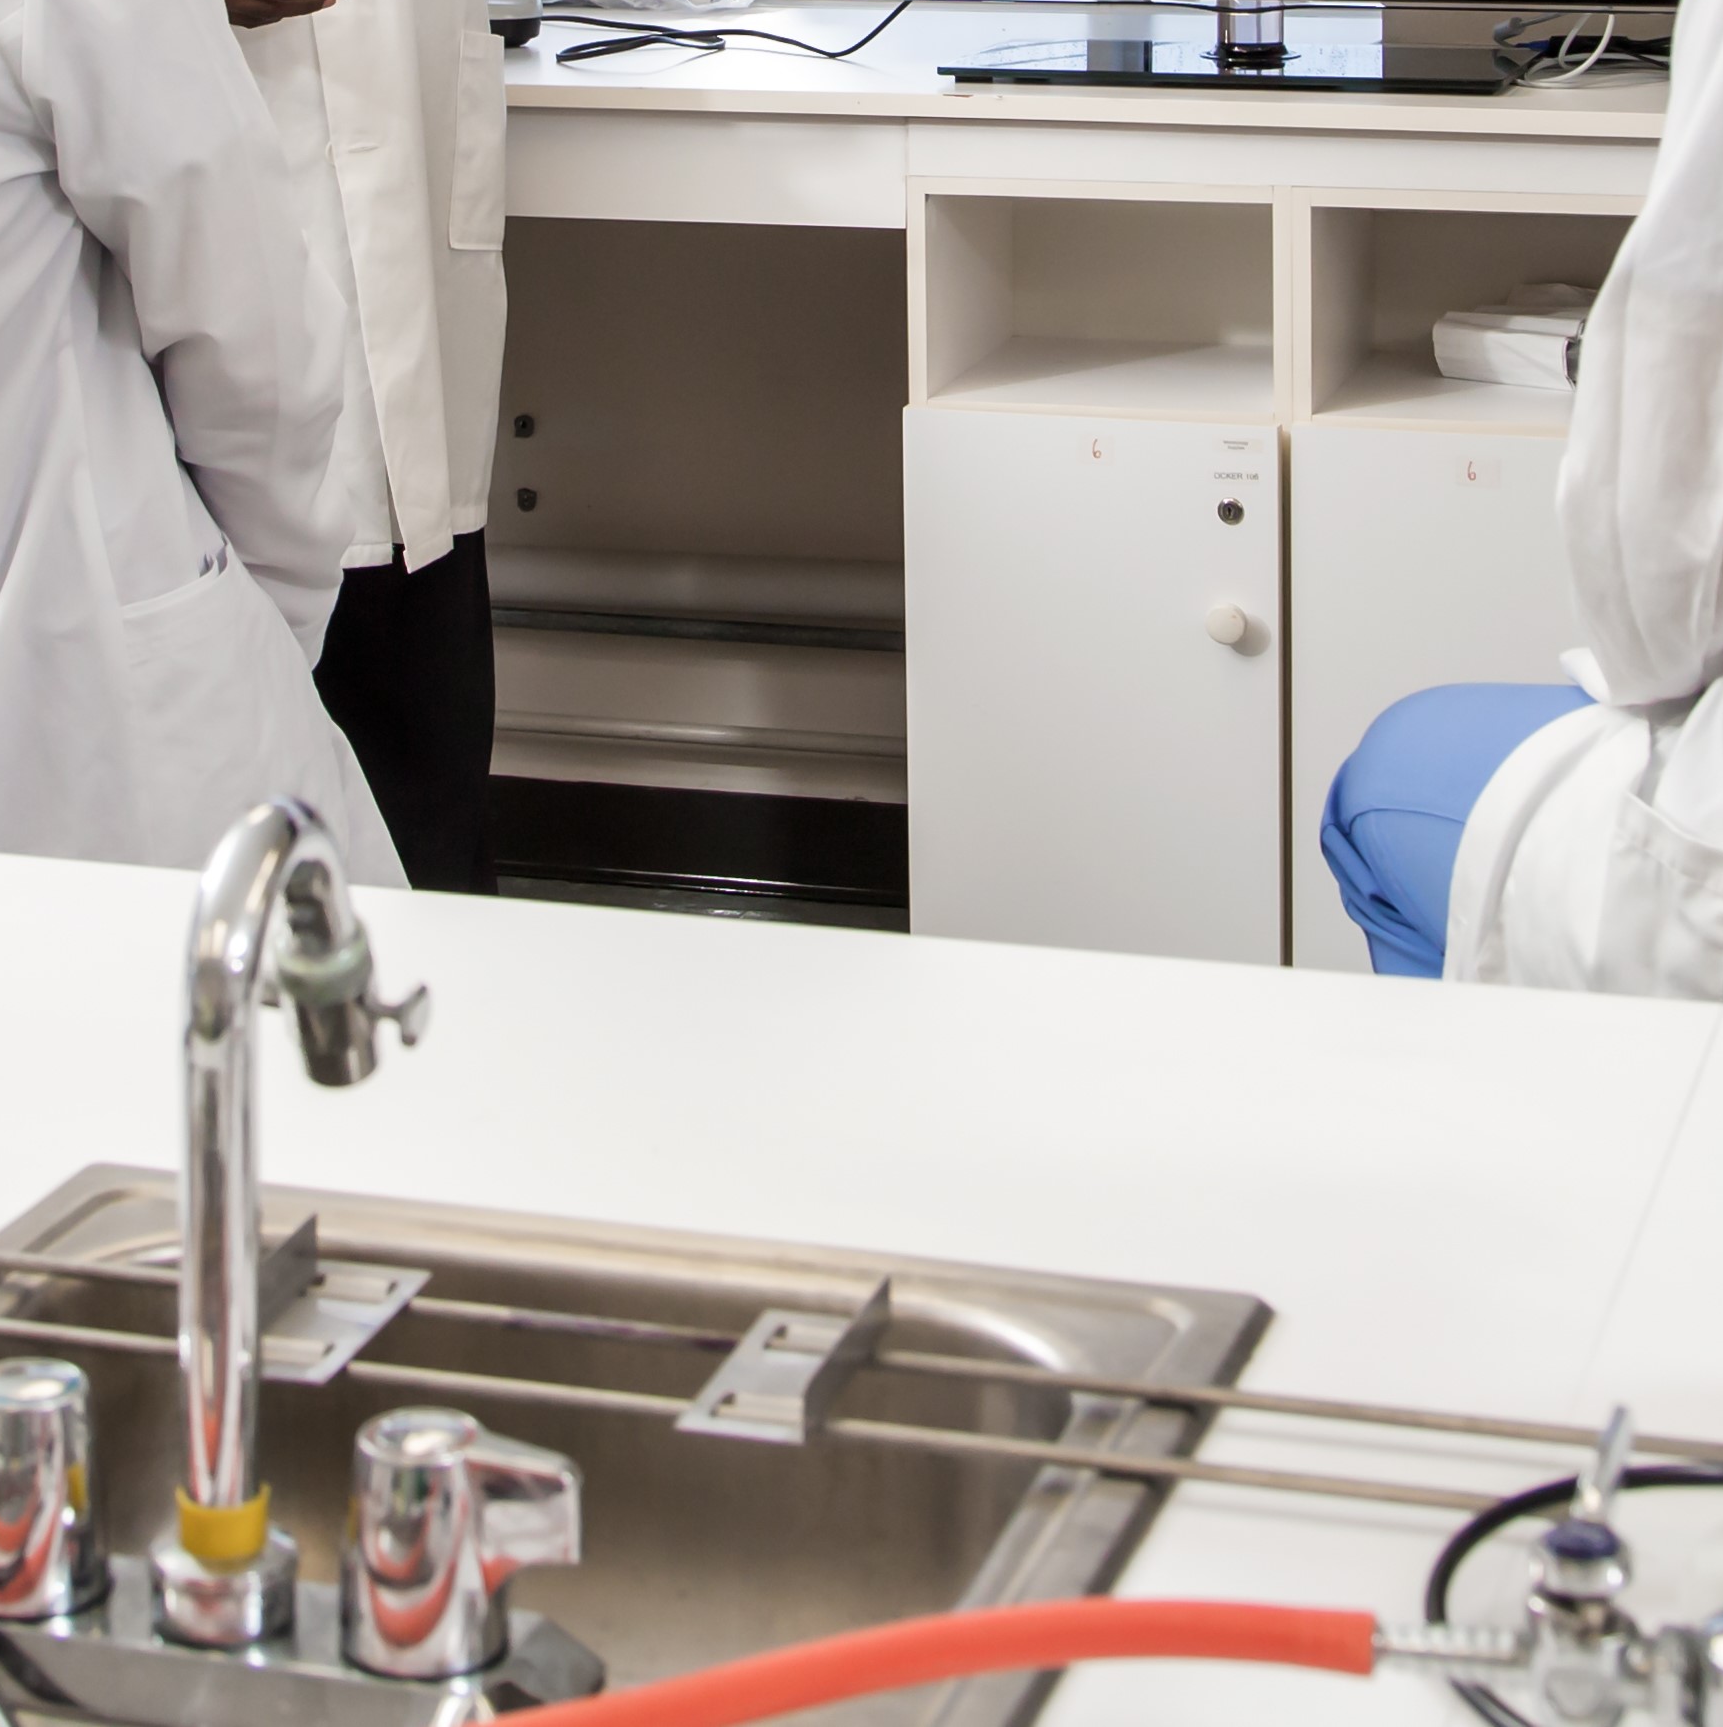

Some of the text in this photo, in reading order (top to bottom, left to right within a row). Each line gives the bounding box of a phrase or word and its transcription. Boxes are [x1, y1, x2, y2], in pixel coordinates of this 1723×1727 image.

[1092, 438, 1102, 459] 6
[1213, 472, 1243, 480] OCKER
[1467, 461, 1477, 481] 6
